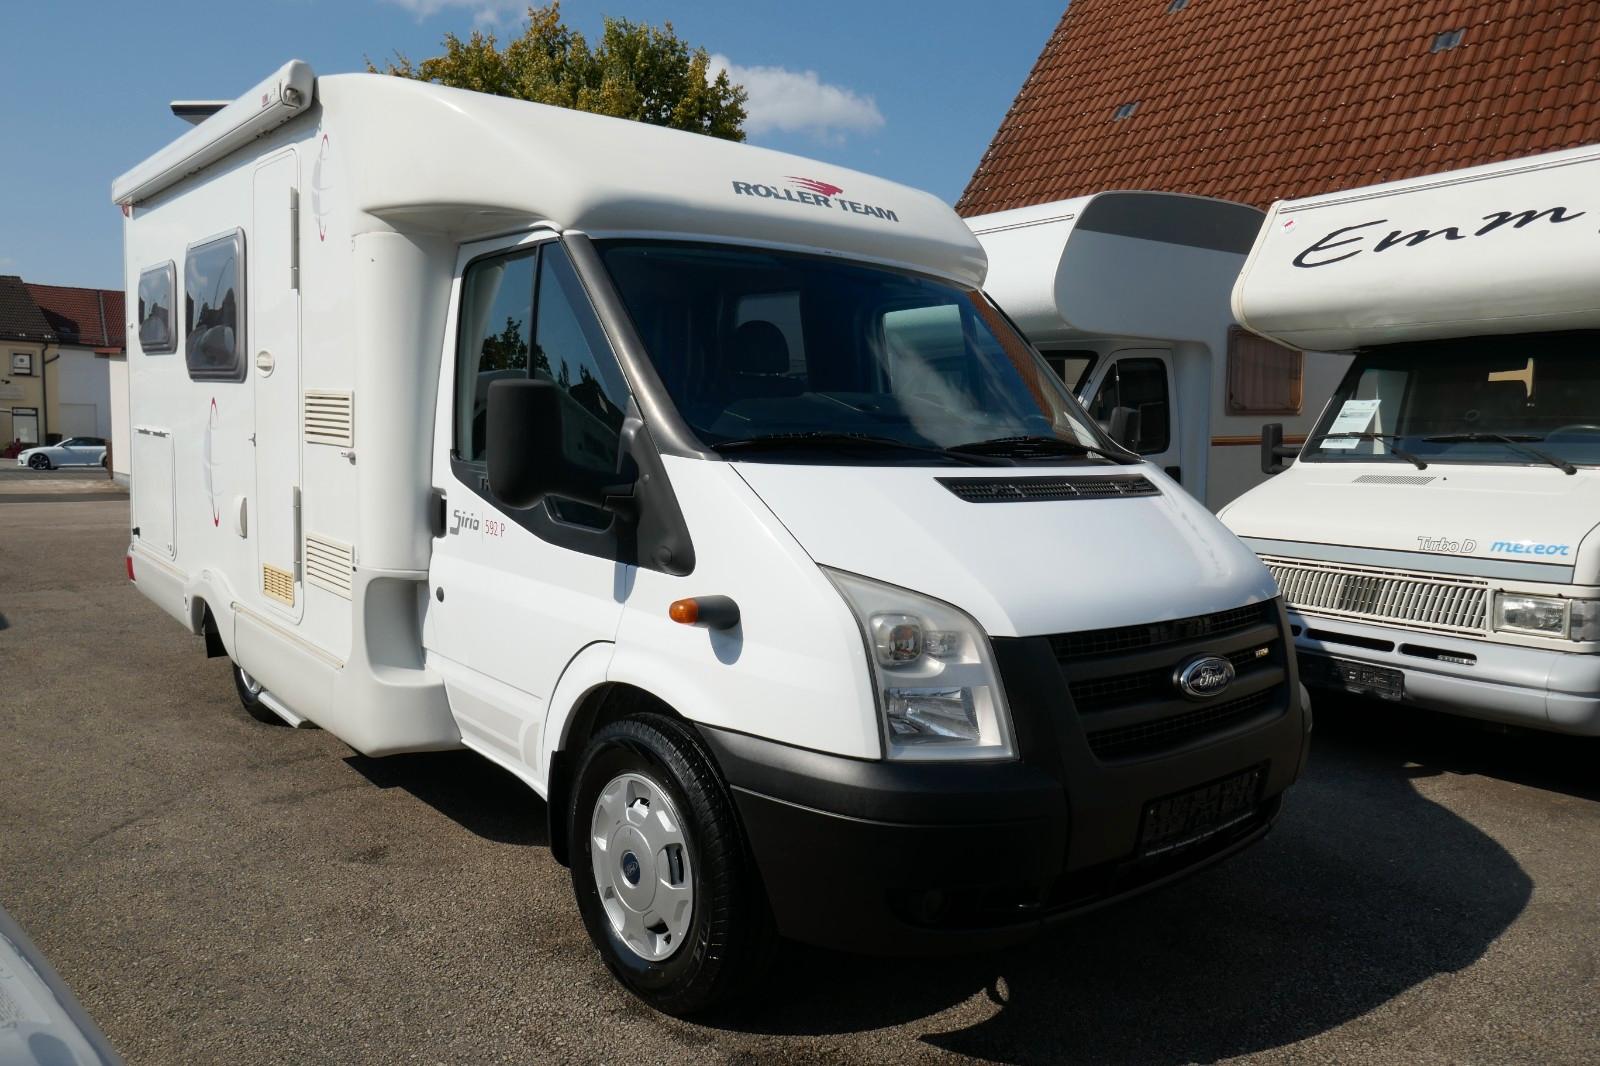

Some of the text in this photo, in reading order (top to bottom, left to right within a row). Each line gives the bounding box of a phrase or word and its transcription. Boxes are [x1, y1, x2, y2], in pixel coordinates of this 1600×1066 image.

[732, 181, 899, 222] ROLLER TEAM
[1292, 206, 1600, 268] Emm
[485, 520, 498, 537] 592
[500, 523, 506, 537] P
[1417, 536, 1477, 554] Turbo D
